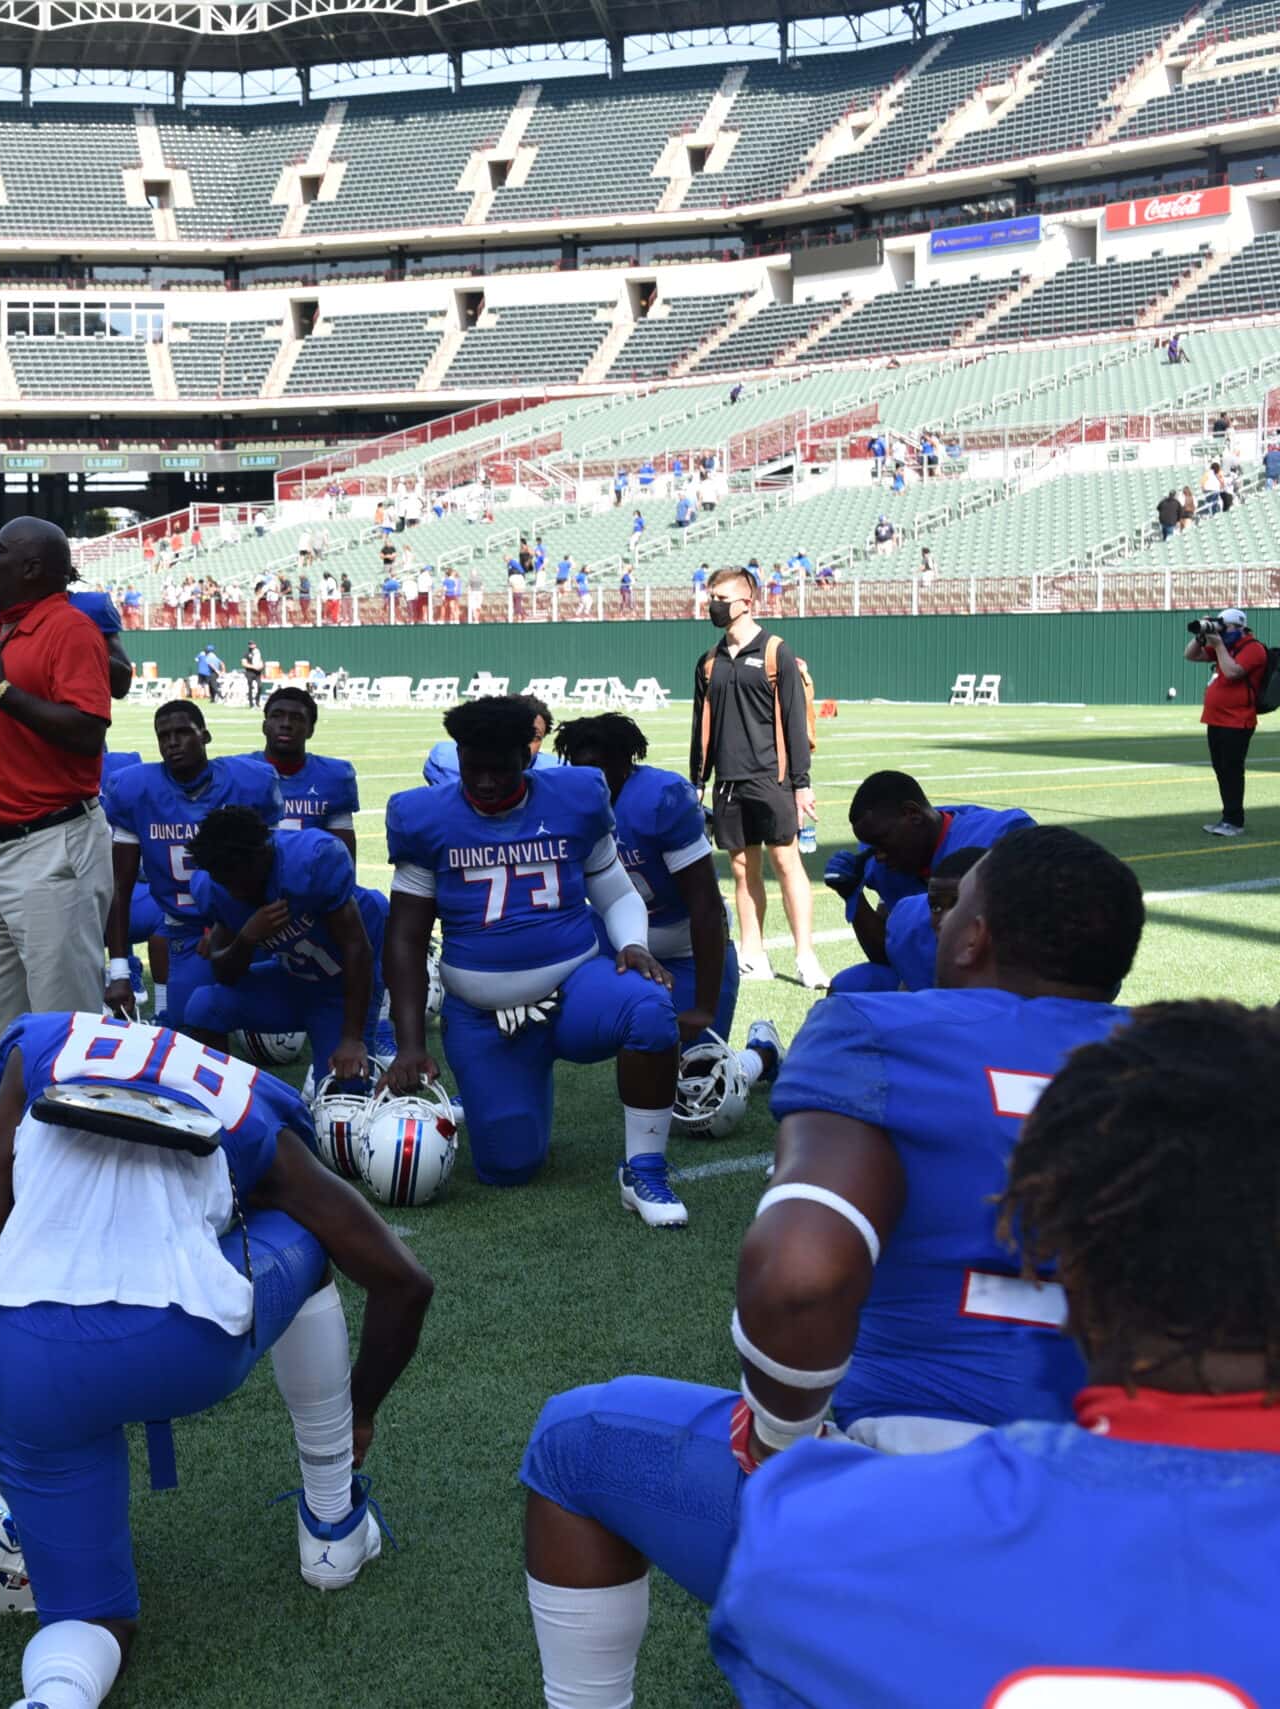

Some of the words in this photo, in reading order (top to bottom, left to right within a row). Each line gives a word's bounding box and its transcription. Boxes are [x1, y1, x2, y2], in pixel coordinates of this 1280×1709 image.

[448, 838, 569, 869] DUNCANVILLE
[462, 859, 561, 928] 73
[50, 1010, 261, 1134] 88
